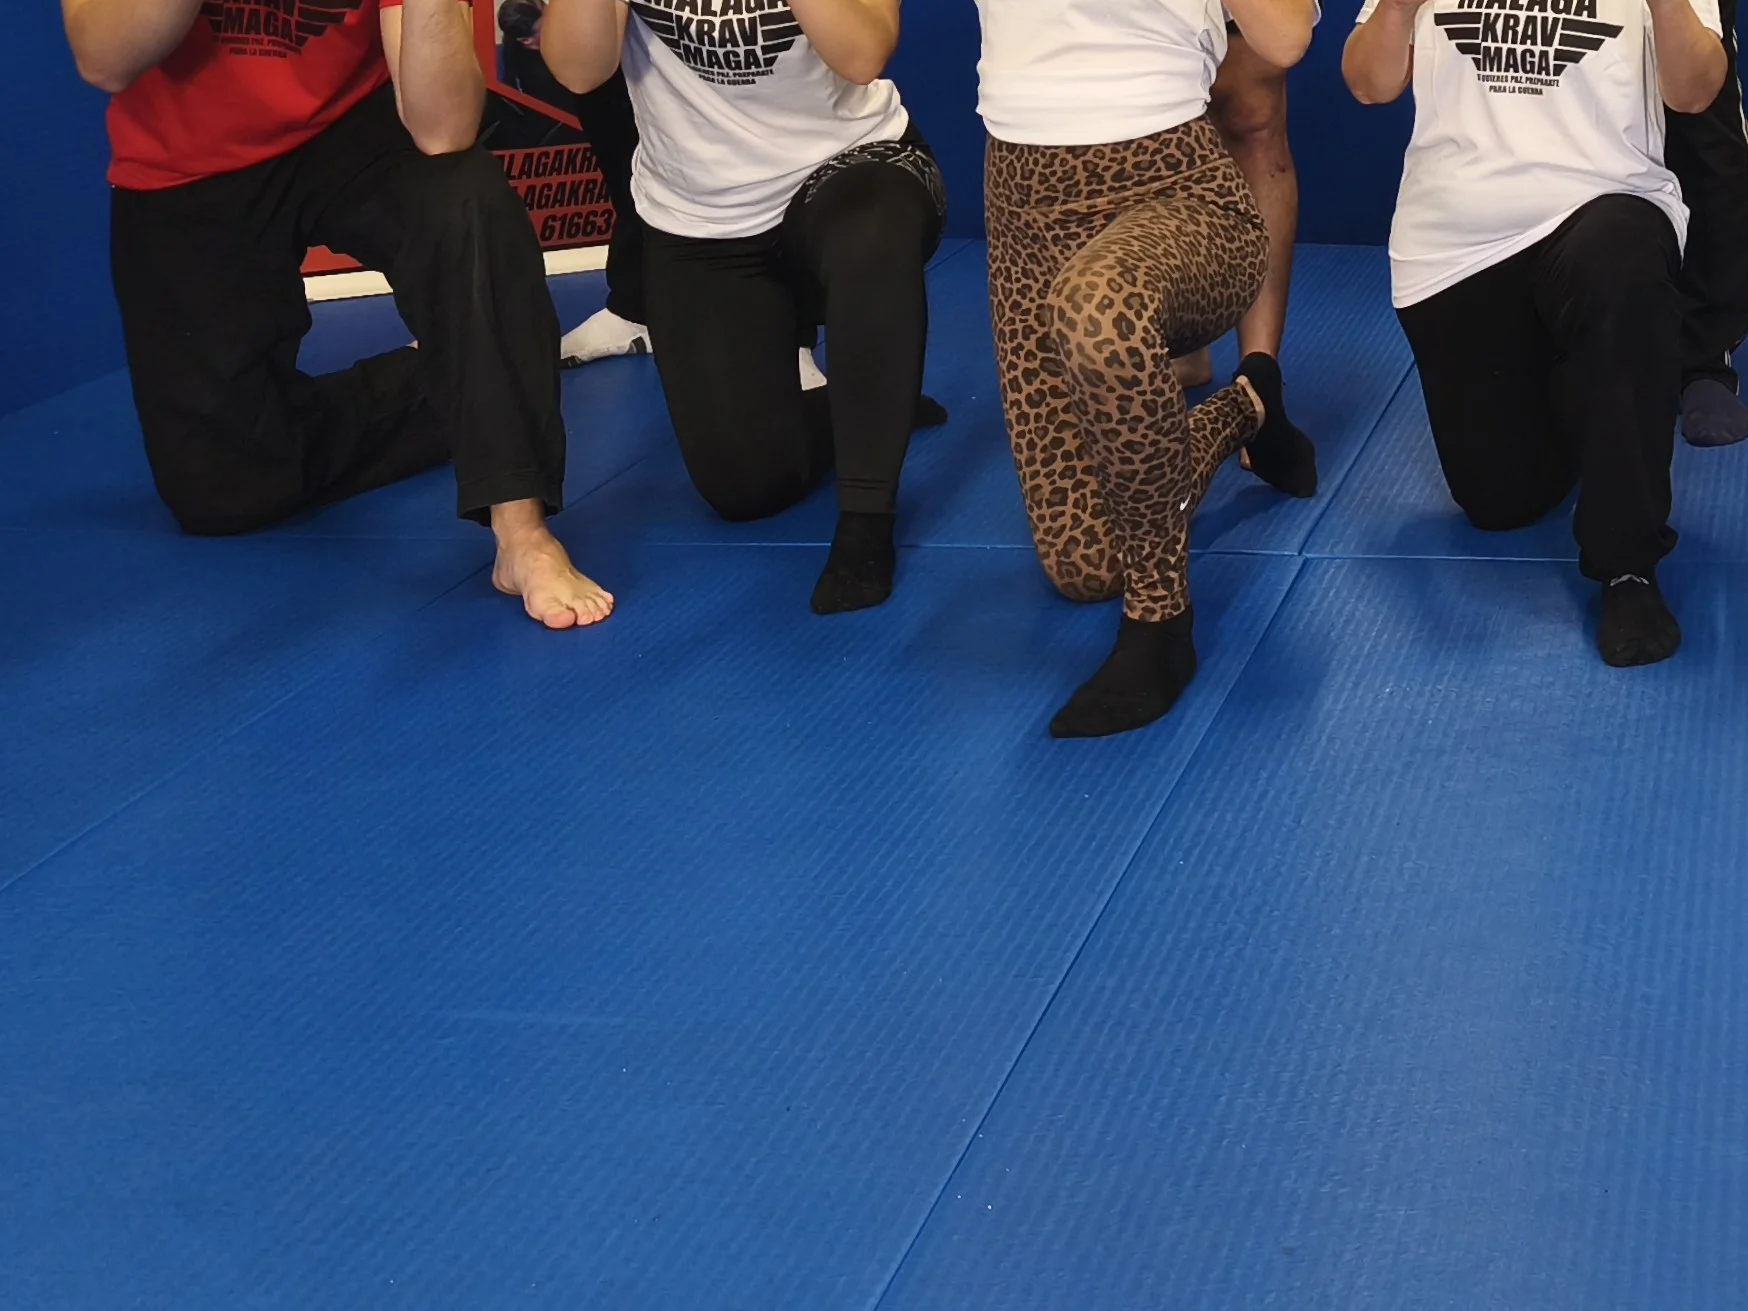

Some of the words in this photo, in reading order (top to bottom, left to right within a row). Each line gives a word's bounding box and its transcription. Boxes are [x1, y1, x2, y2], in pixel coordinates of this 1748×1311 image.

[223, 6, 295, 43] MAGA
[674, 13, 759, 49] KRAV
[1481, 12, 1560, 48] KRAV
[682, 42, 762, 71] MAGA
[1481, 45, 1551, 77] MAGA
[540, 209, 613, 241] 61663
